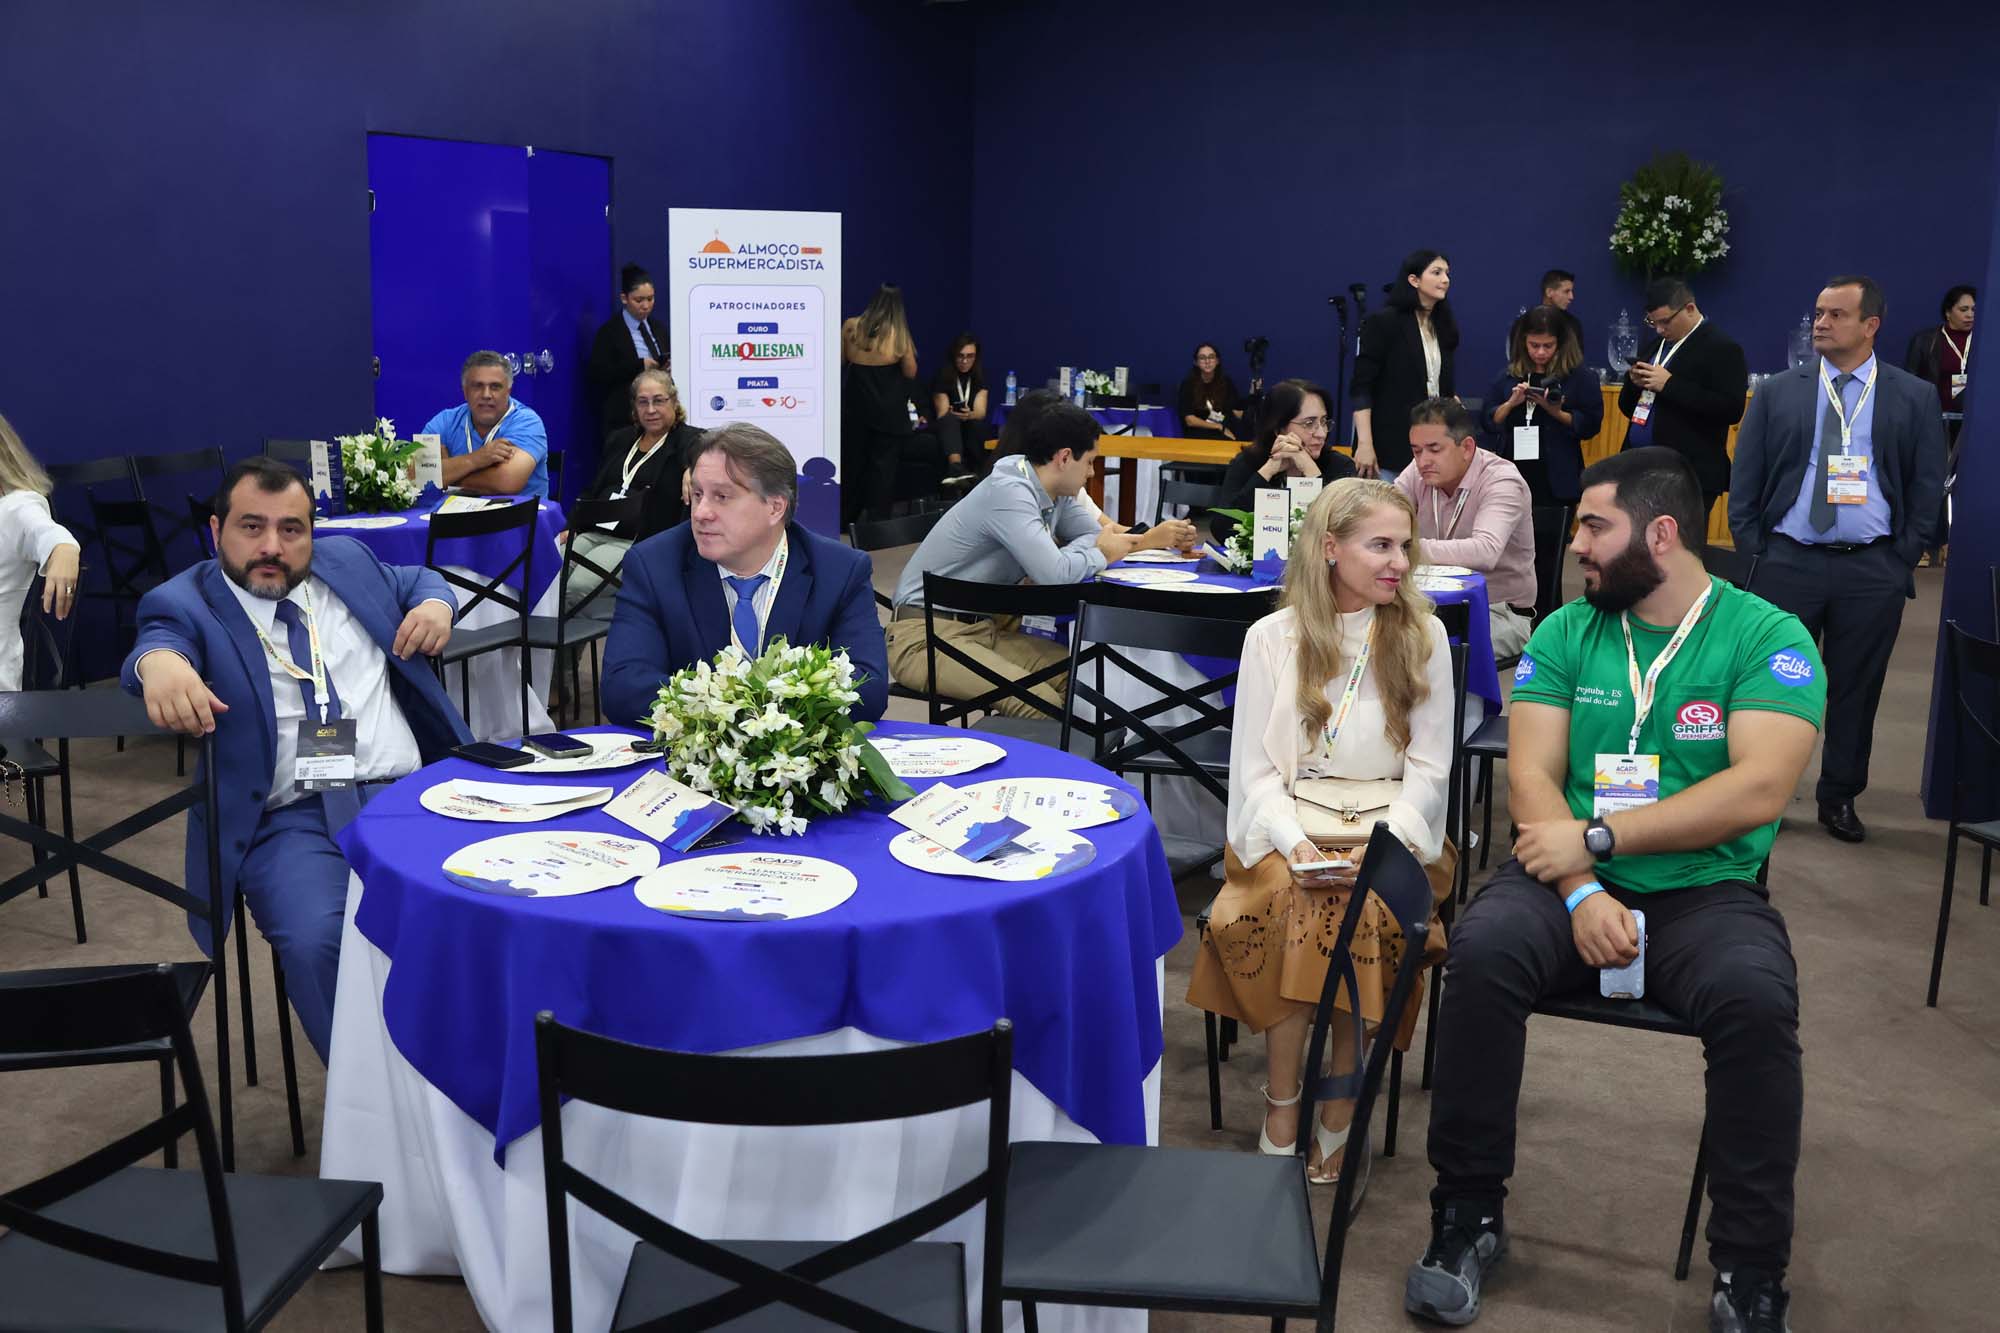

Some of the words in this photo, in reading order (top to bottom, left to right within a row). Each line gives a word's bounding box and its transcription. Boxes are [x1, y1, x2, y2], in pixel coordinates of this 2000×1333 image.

[738, 243, 800, 257] ALMOÇO
[688, 257, 824, 270] SUPERMERCADISTA
[709, 302, 806, 310] PATROCINADORES
[711, 342, 804, 360] MARQUESPAN
[1772, 654, 1812, 678] Felitá
[1611, 689, 1623, 697] ES
[1672, 723, 1725, 734] GRIFFO
[645, 792, 678, 817] MENU
[935, 805, 969, 827] MENU
[751, 856, 803, 865] ACAPS
